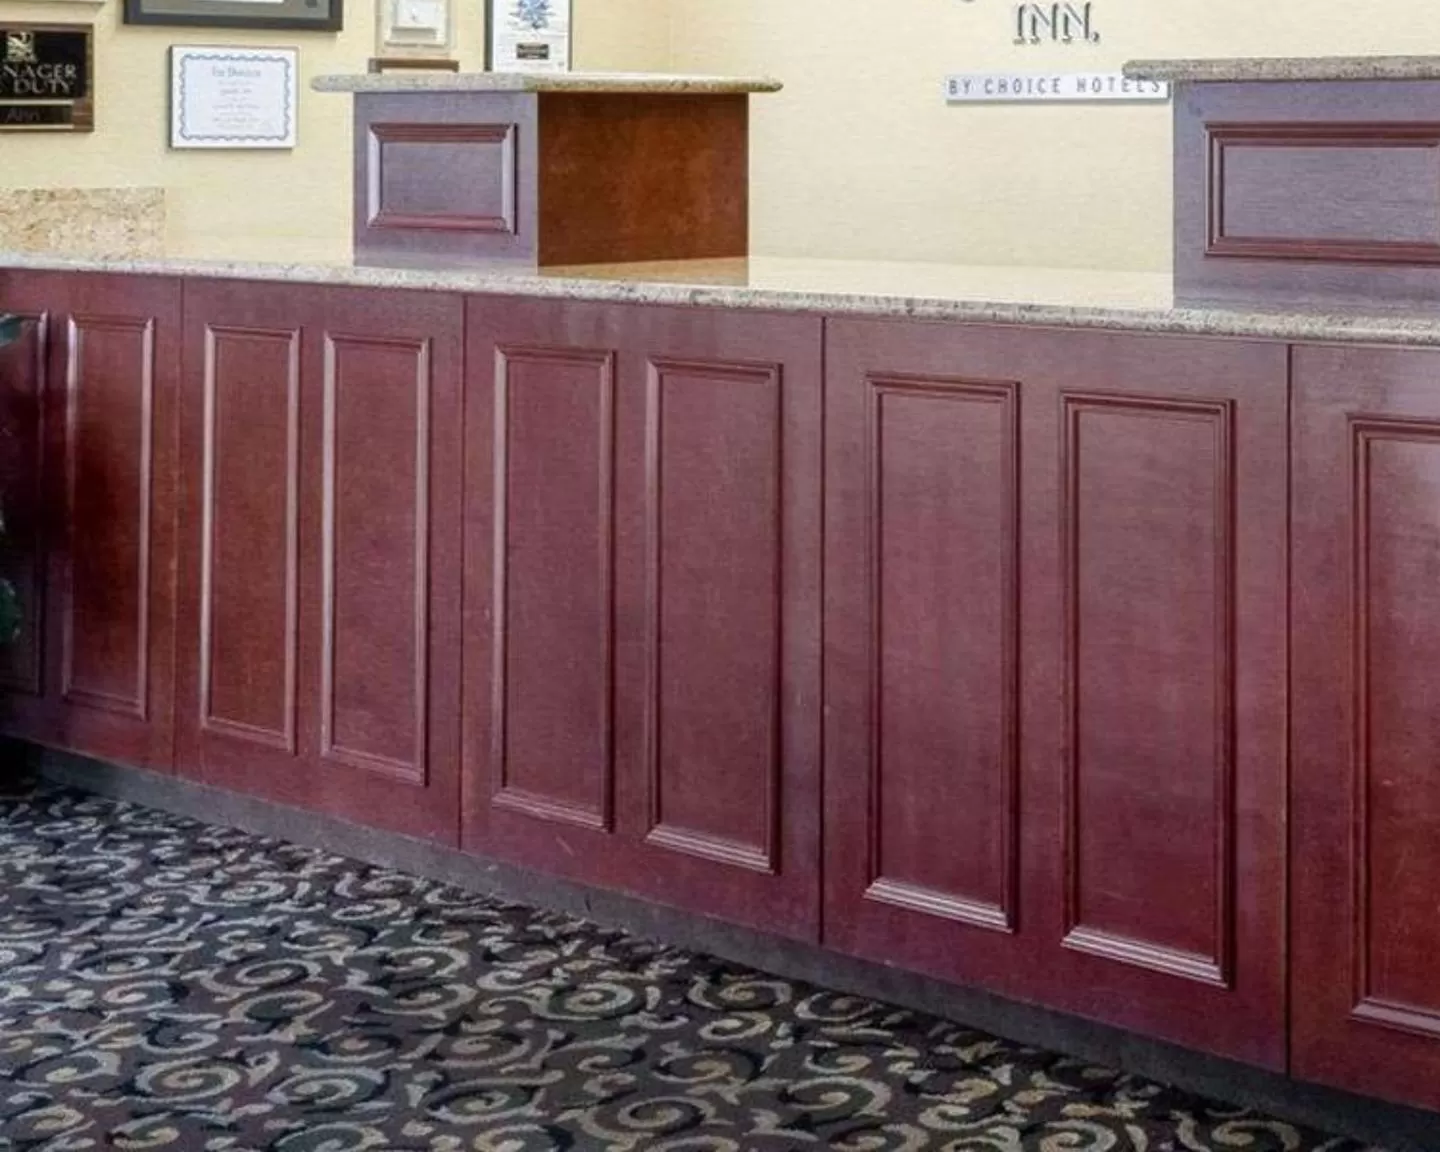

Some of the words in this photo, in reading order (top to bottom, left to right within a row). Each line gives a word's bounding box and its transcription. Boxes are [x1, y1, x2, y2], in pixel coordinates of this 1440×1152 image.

[948, 78, 973, 96] BY
[983, 76, 1062, 95] CHOICE
[1075, 75, 1161, 94] HOTELS
